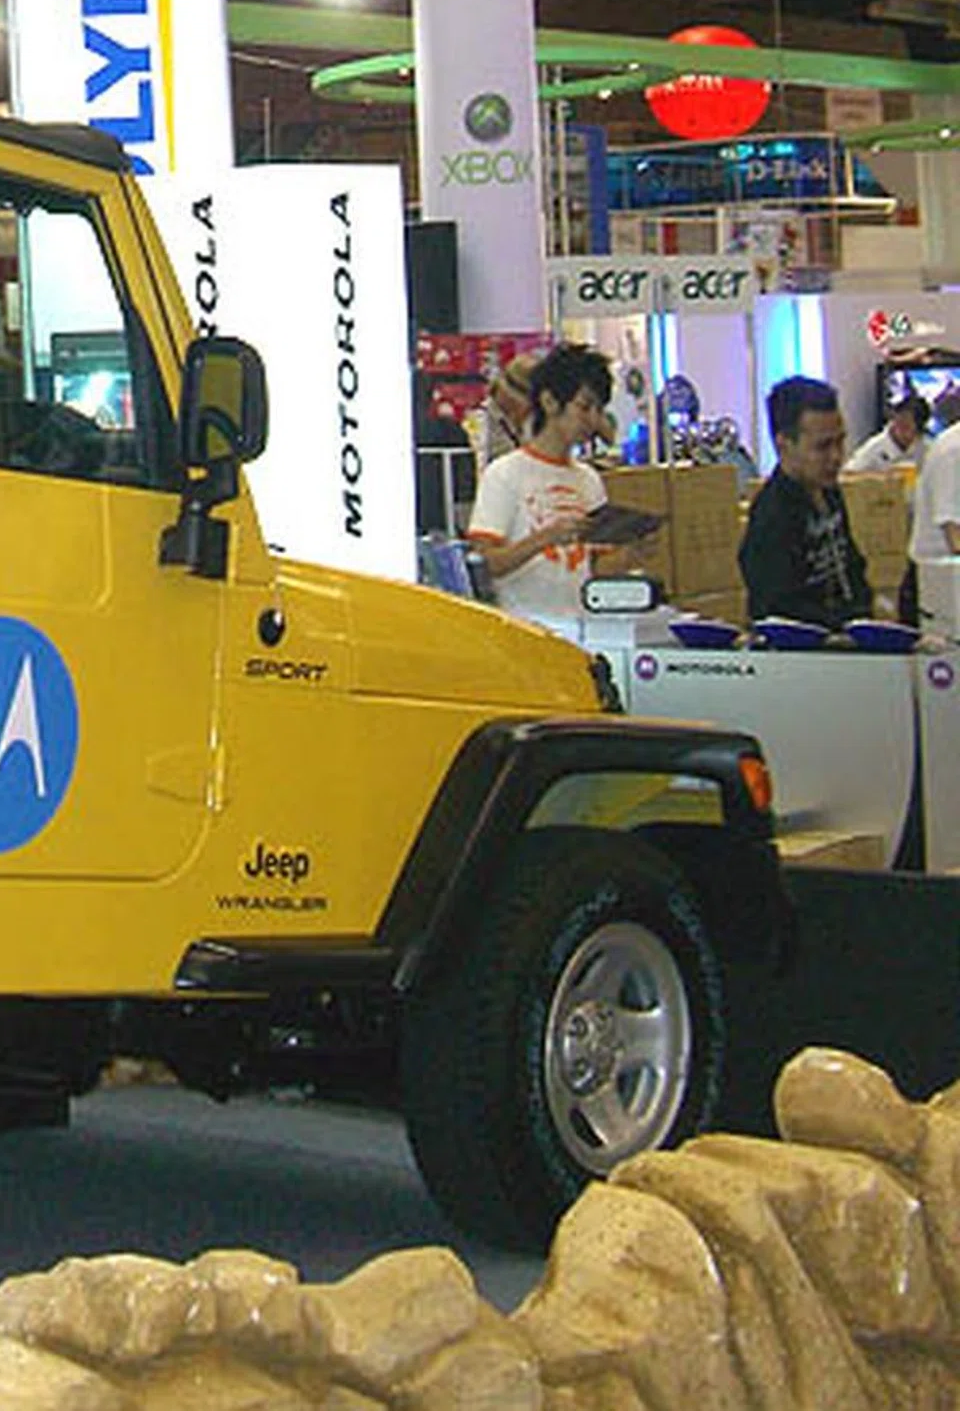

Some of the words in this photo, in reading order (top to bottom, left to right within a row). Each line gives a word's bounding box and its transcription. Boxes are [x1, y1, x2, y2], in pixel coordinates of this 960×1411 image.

[578, 269, 650, 303] acer
[682, 269, 750, 301] acer
[330, 189, 363, 538] MOTOROLA
[245, 658, 328, 682] SPORT
[244, 843, 310, 882] Jeep
[214, 895, 328, 911] WRANGLER
